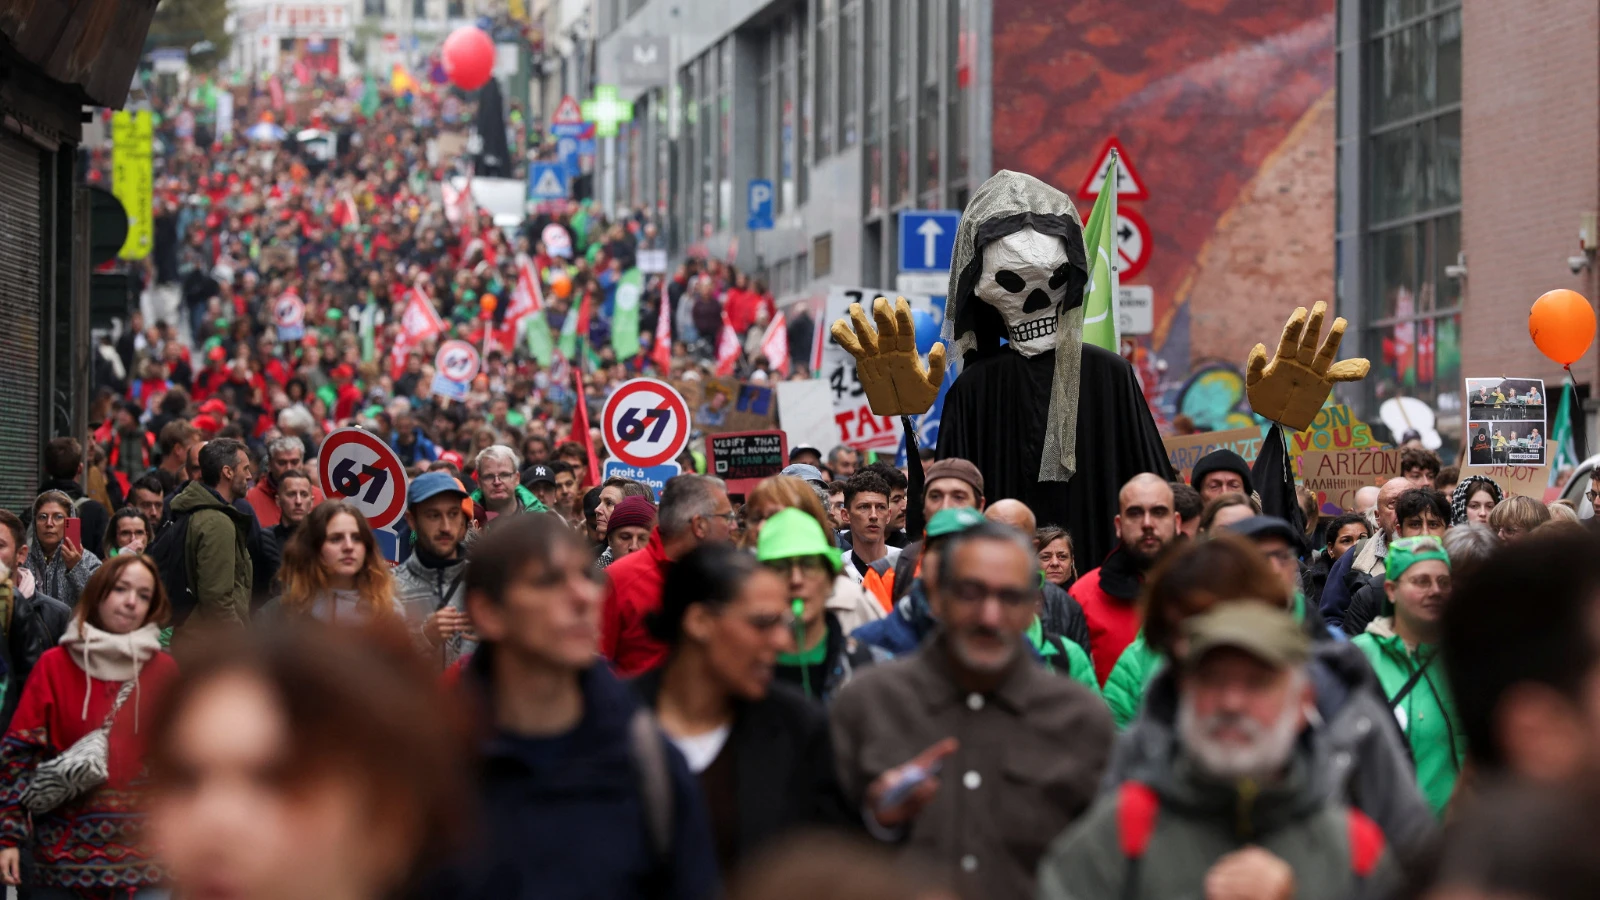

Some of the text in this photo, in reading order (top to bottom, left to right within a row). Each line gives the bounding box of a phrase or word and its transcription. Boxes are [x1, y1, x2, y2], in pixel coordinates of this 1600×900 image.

[751, 184, 770, 212] P
[616, 407, 671, 443] 67
[714, 436, 780, 448] VERIFY THAT
[731, 447, 745, 455] ARE
[748, 446, 780, 454] HUMAN
[1293, 425, 1370, 452] VOUS
[609, 467, 635, 478] droit
[1317, 451, 1397, 477] ARIZON
[332, 457, 388, 505] 67
